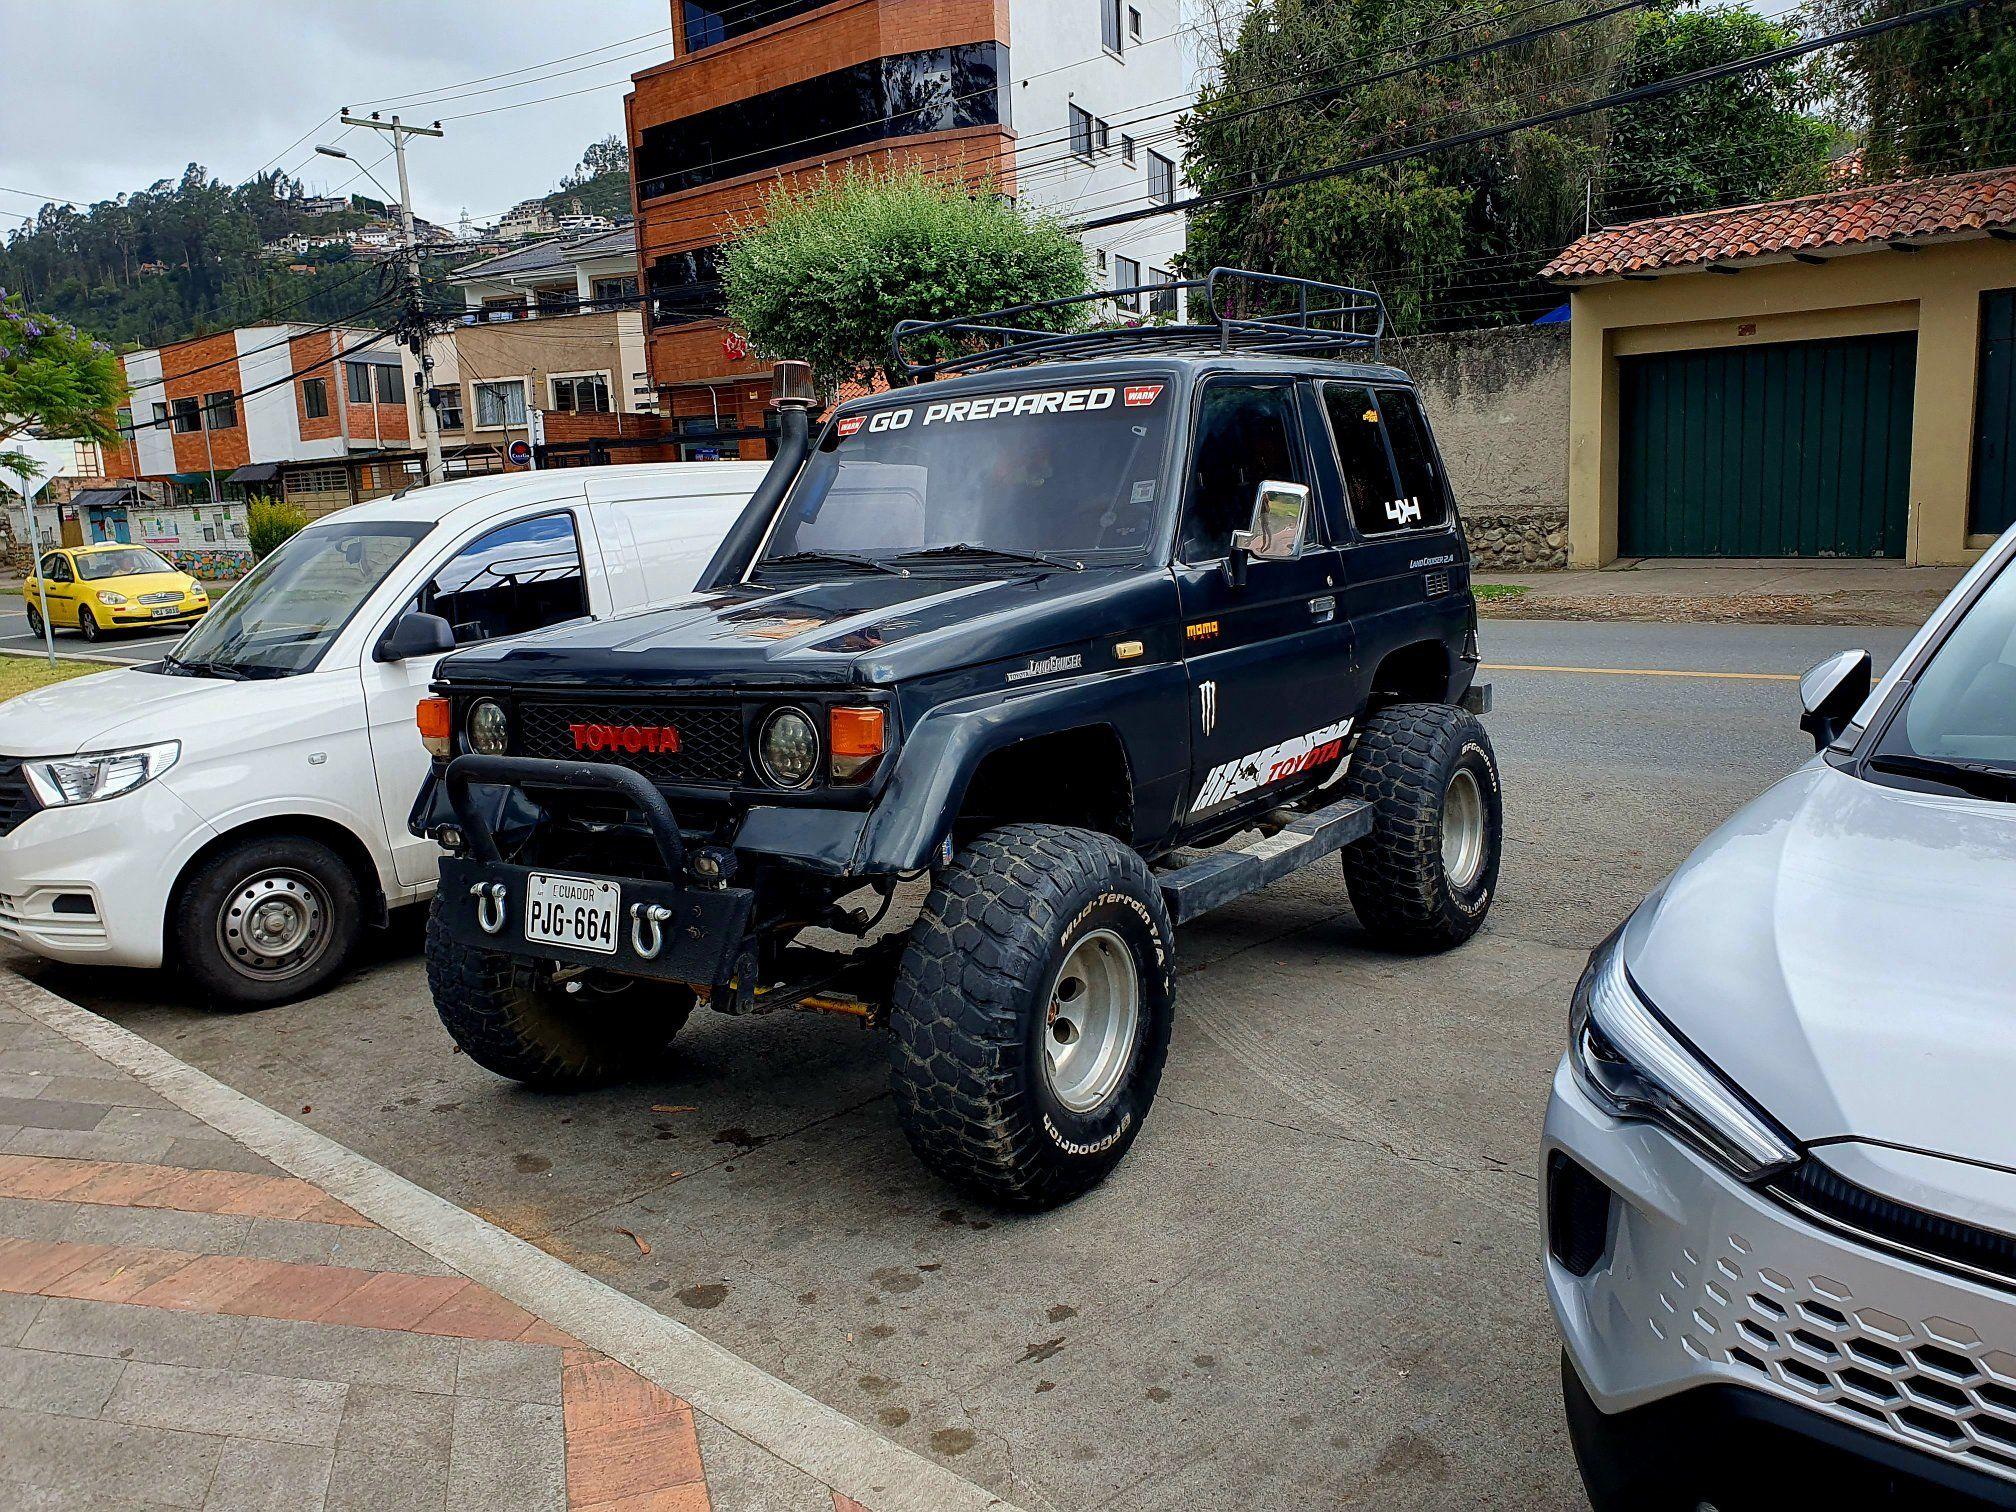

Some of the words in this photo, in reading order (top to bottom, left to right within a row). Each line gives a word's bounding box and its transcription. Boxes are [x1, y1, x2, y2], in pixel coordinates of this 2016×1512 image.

[868, 409, 914, 433] GO
[922, 388, 1116, 426] PREPARED
[569, 723, 679, 753] TOYOTA
[1264, 739, 1343, 785] TOYOTA
[552, 884, 595, 902] ECUADOR
[530, 900, 612, 945] PJG-664
[1060, 892, 1151, 947] Mud-Terrain
[1043, 1112, 1131, 1155] BFGoodrich
